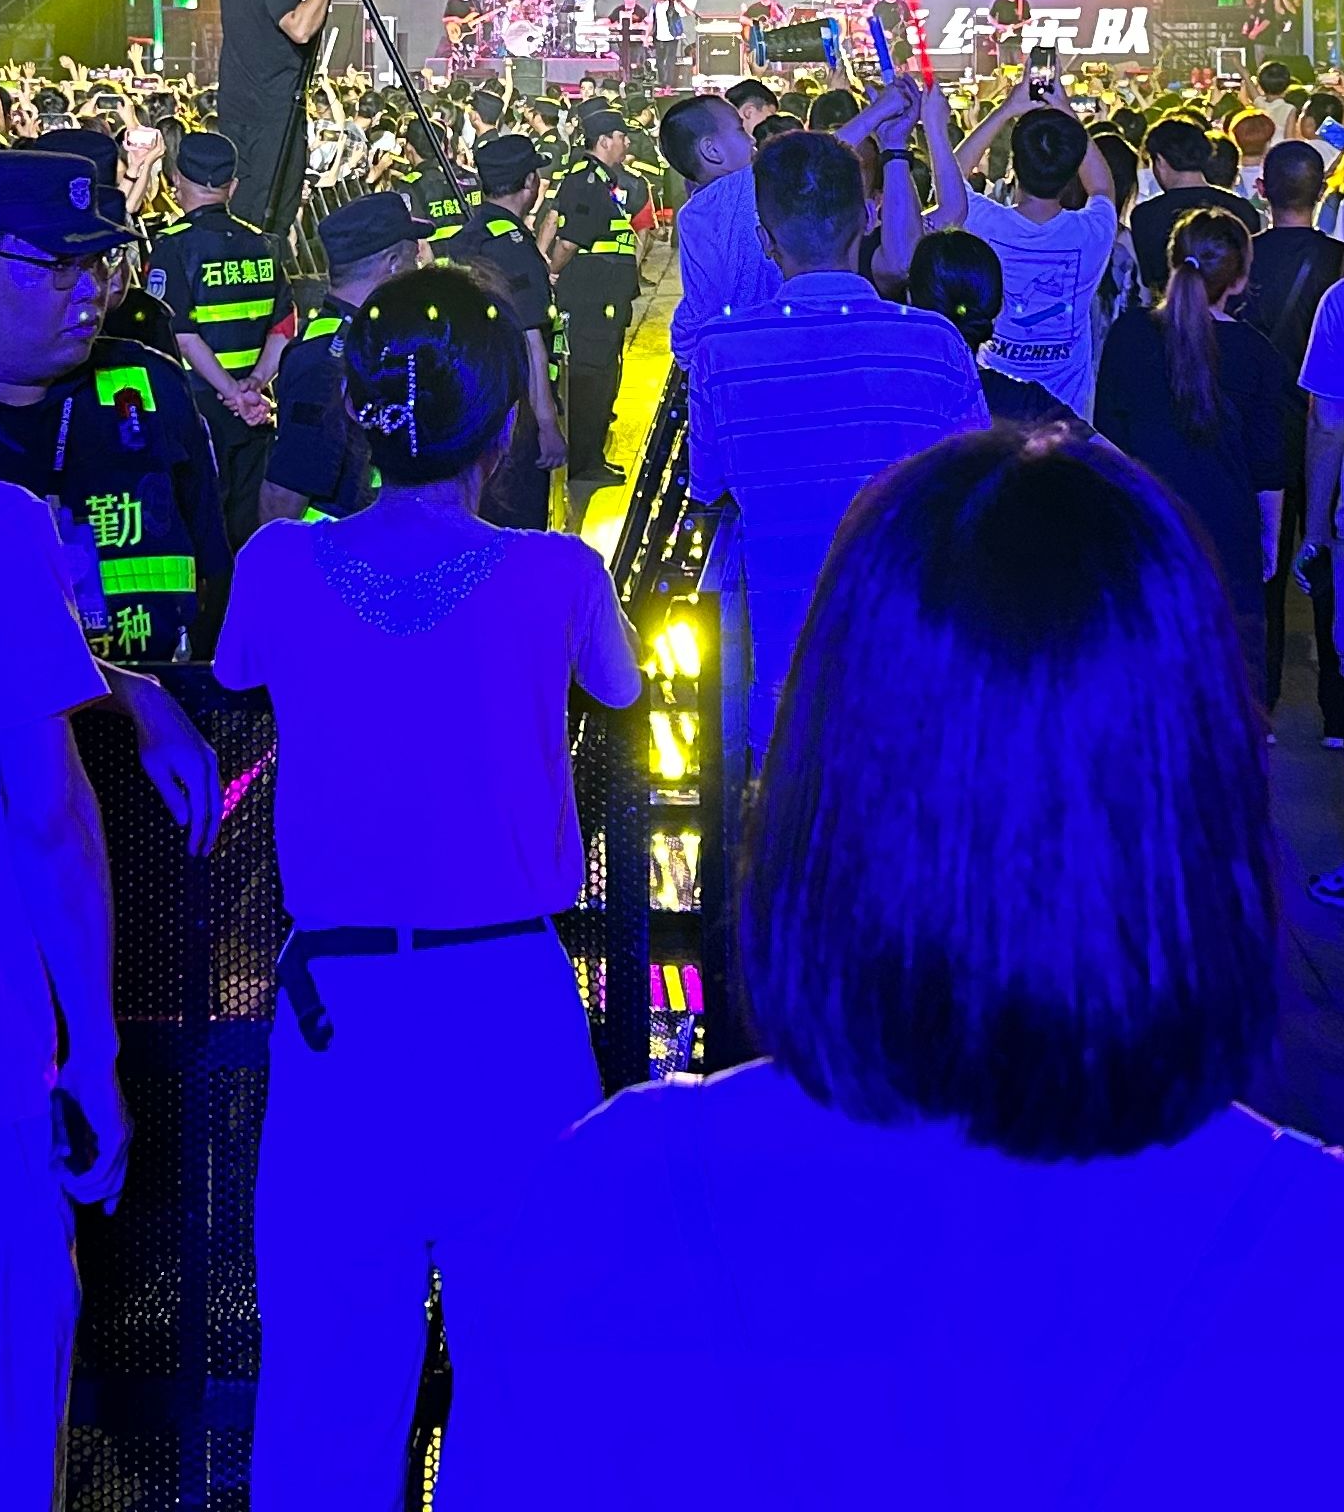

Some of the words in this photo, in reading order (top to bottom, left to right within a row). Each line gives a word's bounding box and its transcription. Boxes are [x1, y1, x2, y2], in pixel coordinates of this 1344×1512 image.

[202, 259, 274, 287] 石保集团
[988, 337, 1073, 362] SKECHERS
[86, 493, 142, 547] 勤
